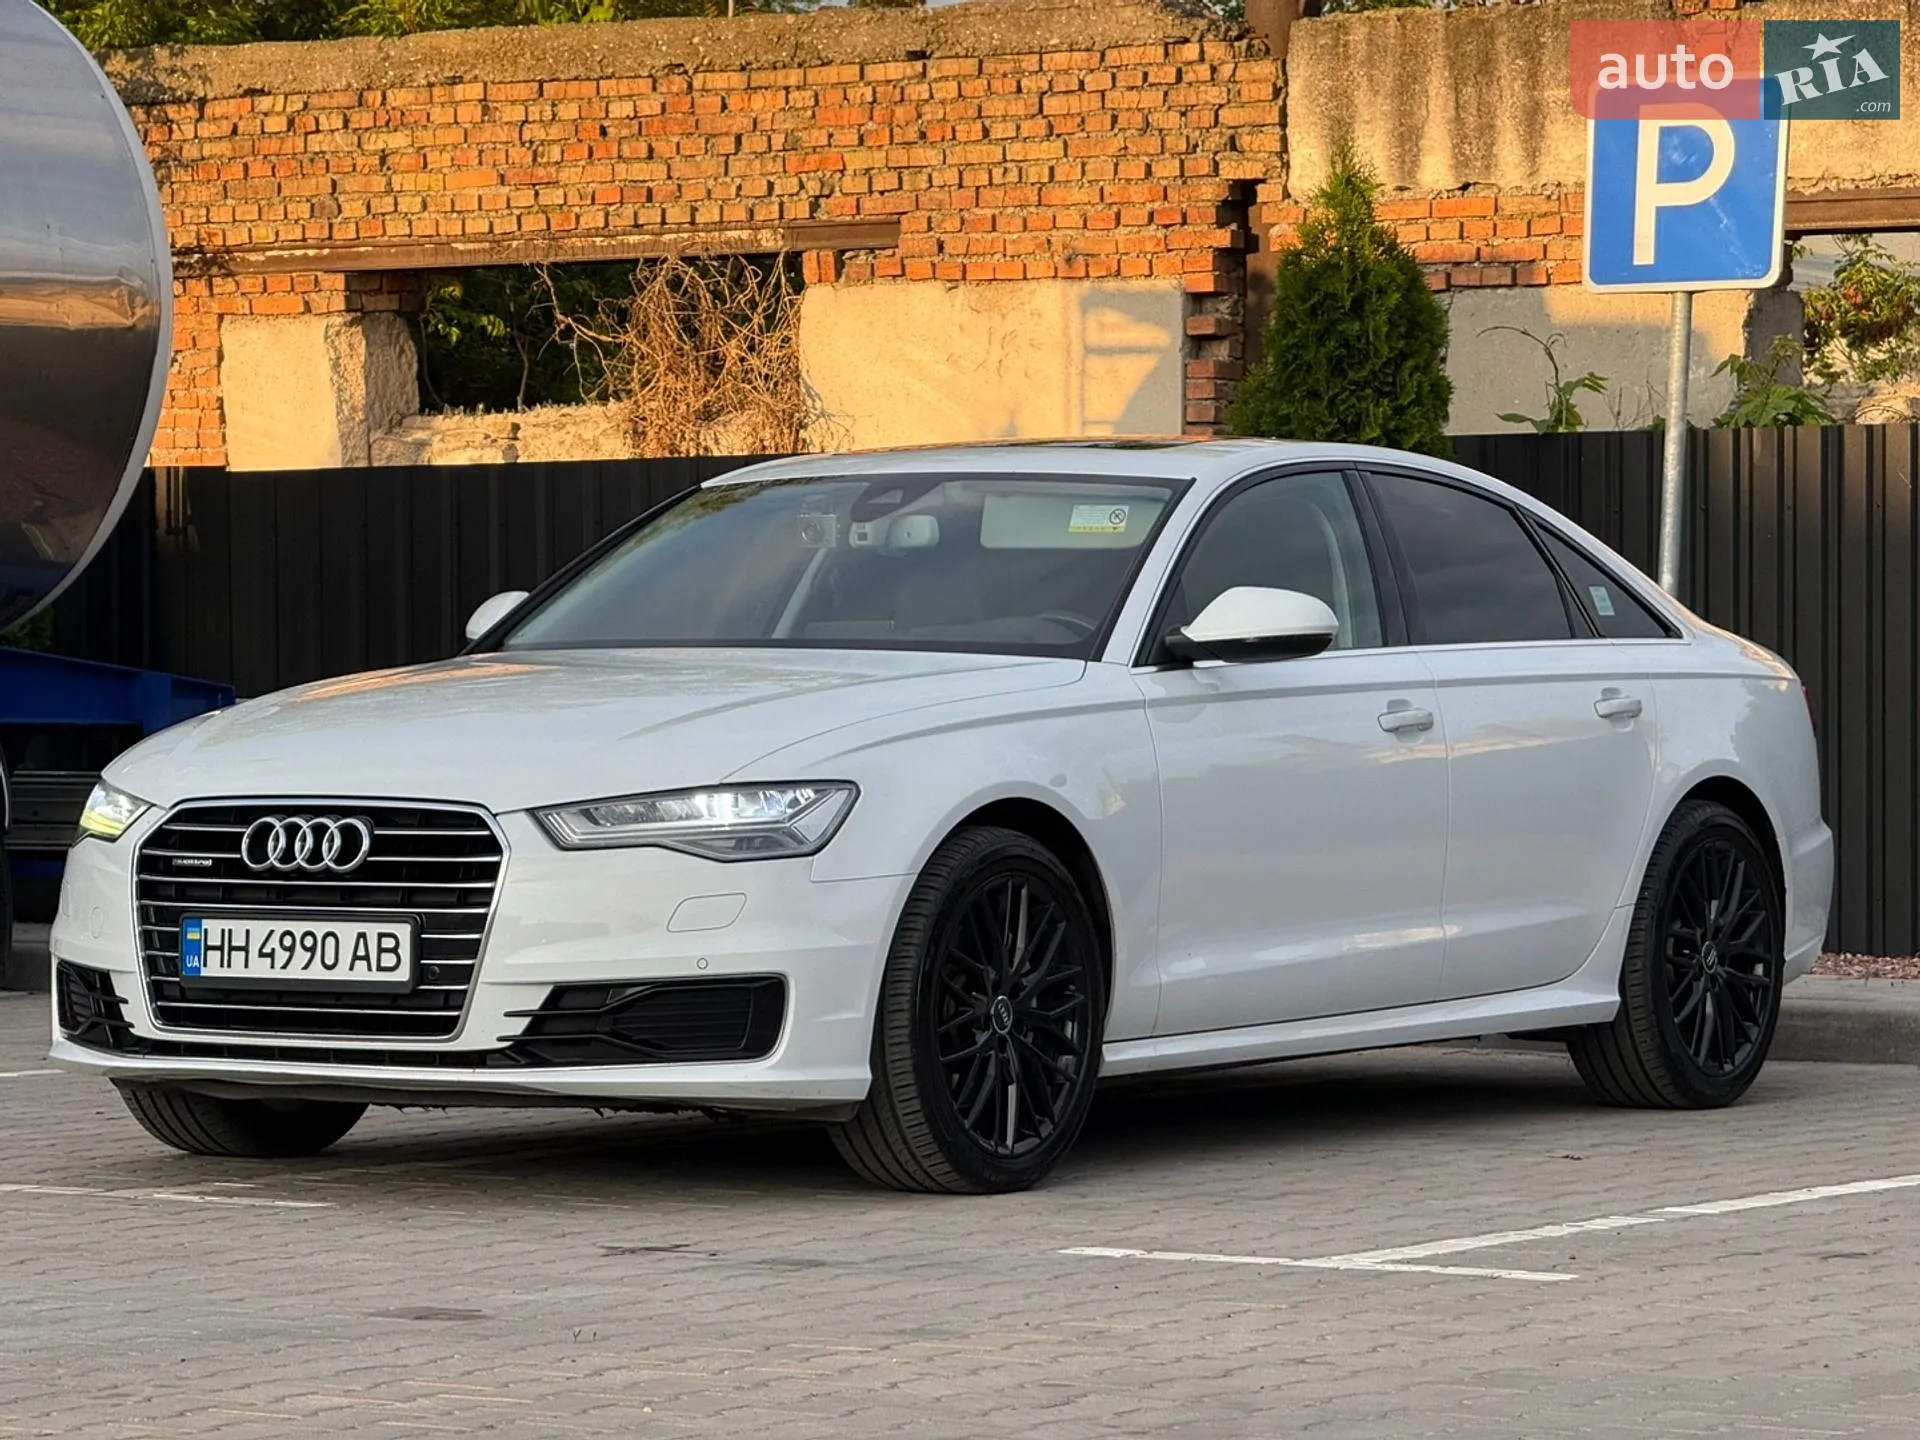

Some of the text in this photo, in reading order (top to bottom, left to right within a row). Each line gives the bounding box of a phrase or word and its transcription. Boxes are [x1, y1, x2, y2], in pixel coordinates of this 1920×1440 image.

[1633, 102, 1735, 266] P
[186, 955, 200, 968] UA
[203, 928, 401, 972] HH 4990 AB
